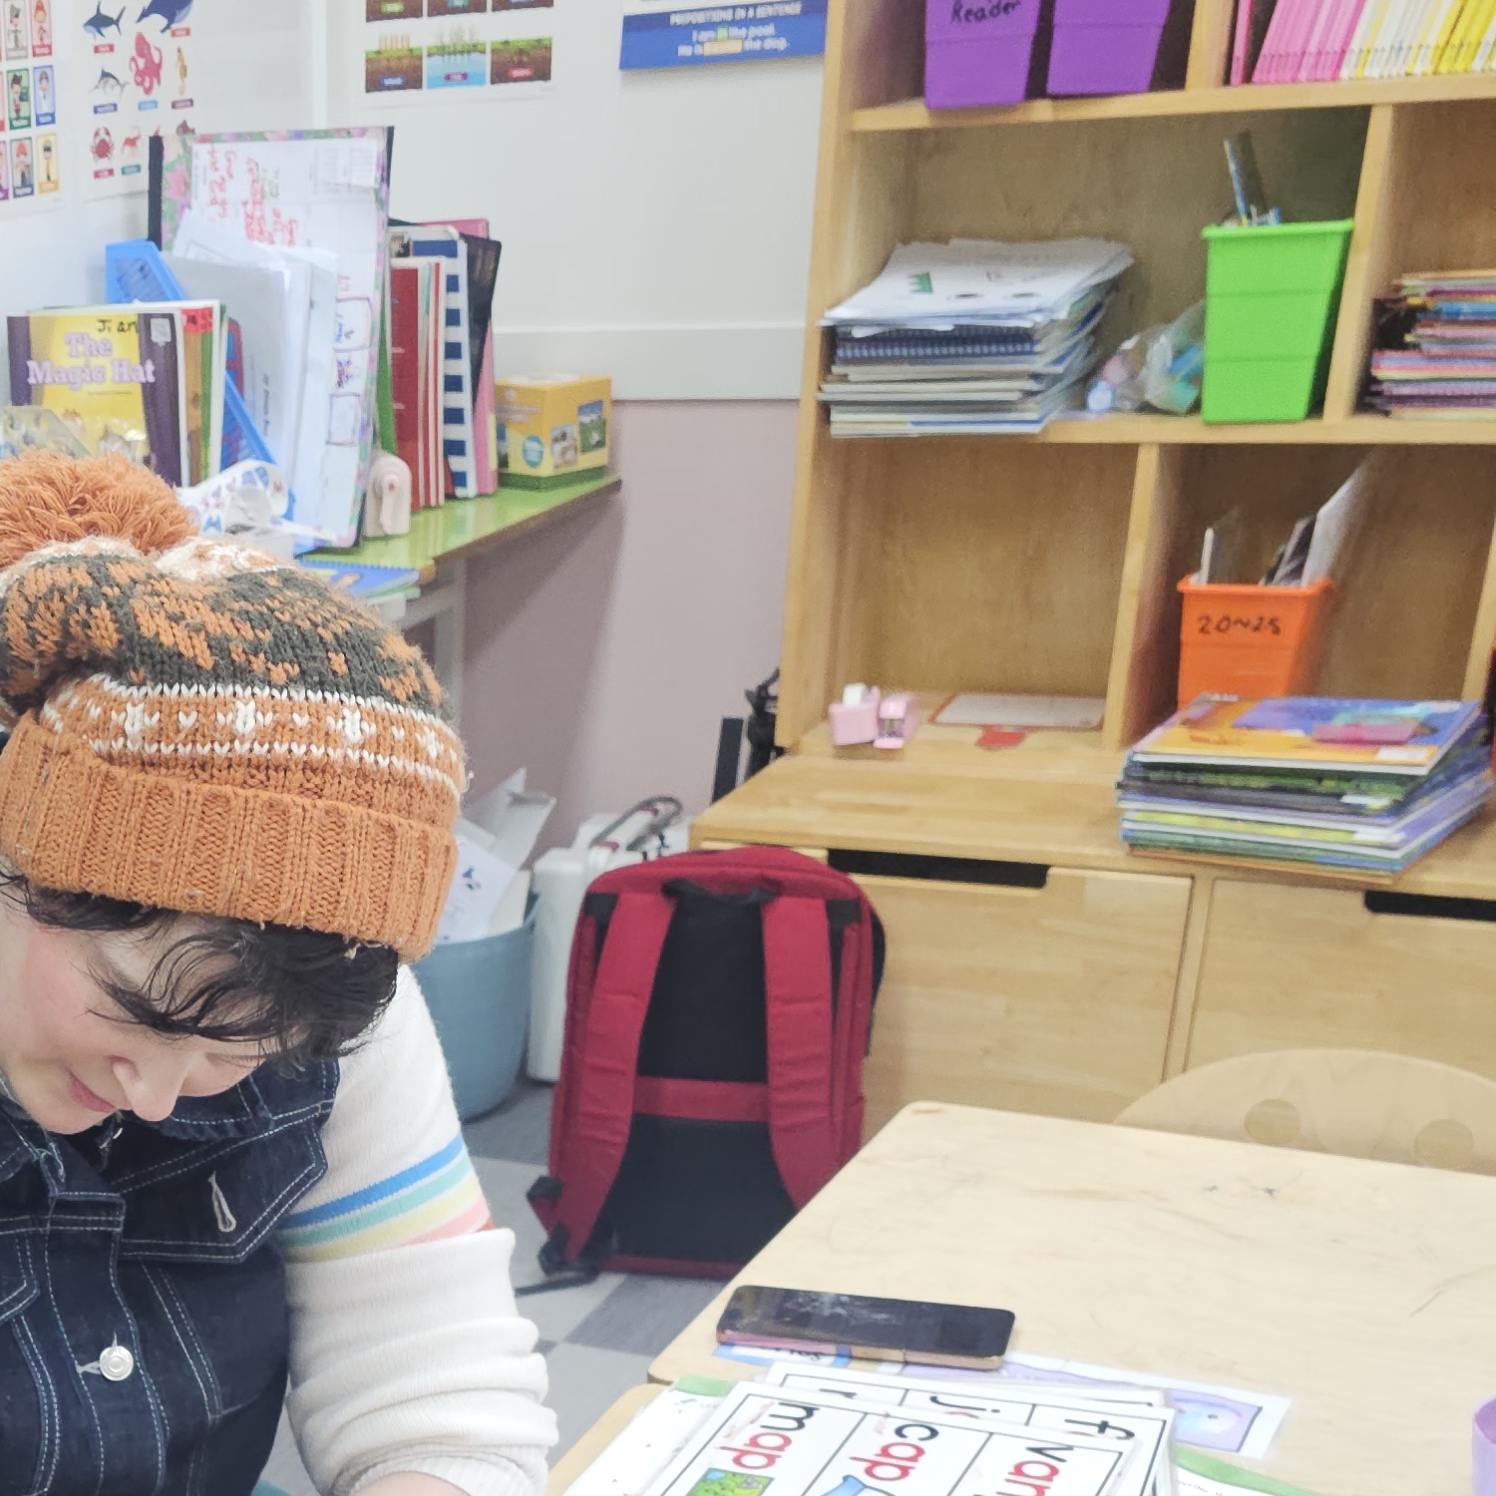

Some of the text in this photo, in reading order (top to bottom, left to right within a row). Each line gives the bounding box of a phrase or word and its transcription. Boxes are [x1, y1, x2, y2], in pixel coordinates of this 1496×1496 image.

[64, 332, 113, 358] The
[26, 358, 156, 392] Magic Hat
[718, 1400, 821, 1470] map
[849, 1422, 940, 1483] cap
